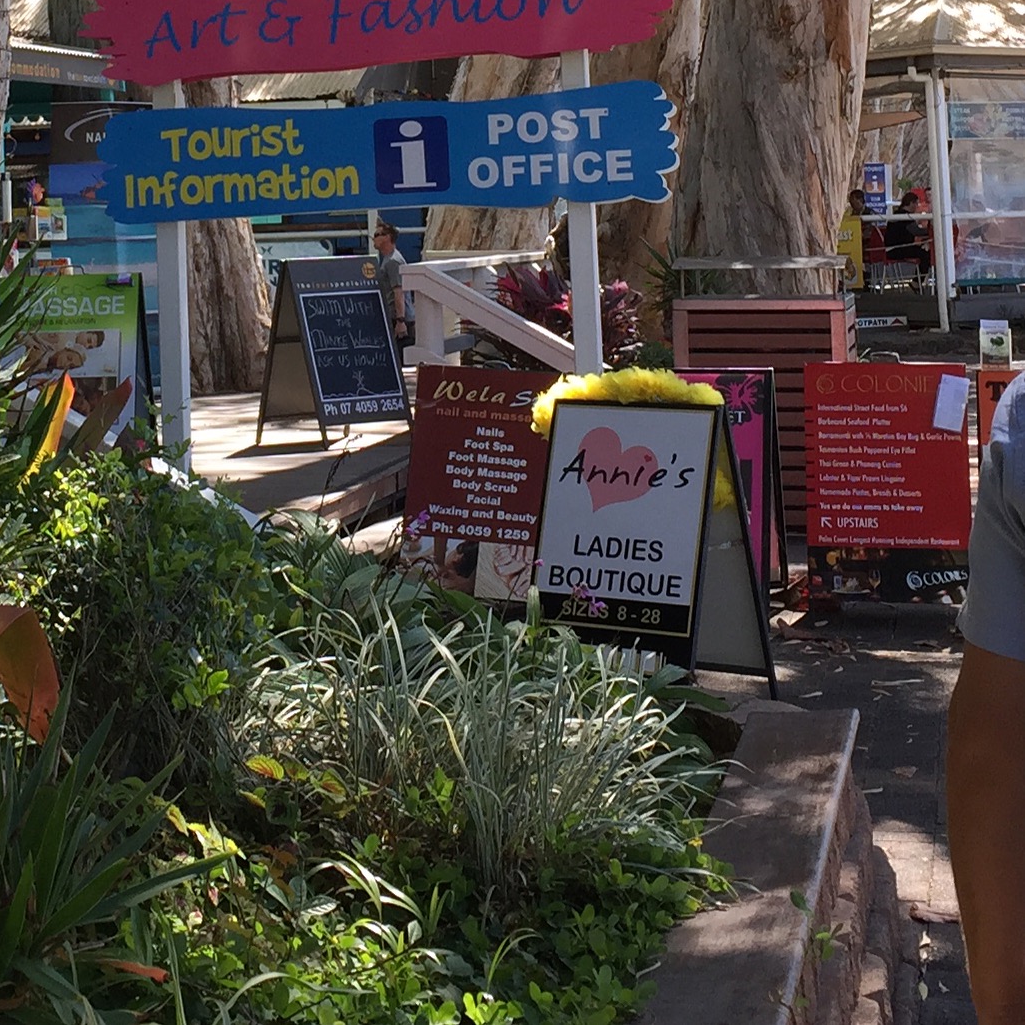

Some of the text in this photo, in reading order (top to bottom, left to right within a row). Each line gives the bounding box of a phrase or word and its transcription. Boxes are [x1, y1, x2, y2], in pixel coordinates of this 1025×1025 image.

[144, 2, 245, 59] Art
[487, 107, 609, 146] POST
[161, 119, 305, 163] Tourist
[467, 149, 633, 190] OFFICE
[125, 165, 359, 209] Information
[855, 319, 888, 327] OTPATH
[433, 379, 537, 408] Wela S
[324, 402, 338, 416] Ph
[339, 402, 352, 415] 07
[355, 400, 379, 414] 4059
[436, 407, 460, 417] nail
[463, 408, 488, 419] and
[476, 426, 505, 438] Nails
[464, 439, 515, 453] Foot Spa
[448, 451, 528, 468] Foot Massage
[558, 449, 695, 489] Annie's
[445, 464, 528, 482] Body Massage
[452, 479, 518, 494] Body Scrub
[466, 494, 502, 506] Facial
[429, 503, 537, 525] Waxing and Beauty
[837, 517, 879, 529] UPSTAIRS
[431, 521, 531, 541] Ph: 4059 1259
[573, 534, 663, 562] LADIES
[548, 565, 683, 598] BOUTIQUE
[617, 605, 627, 621] 8
[640, 608, 661, 624] 28
